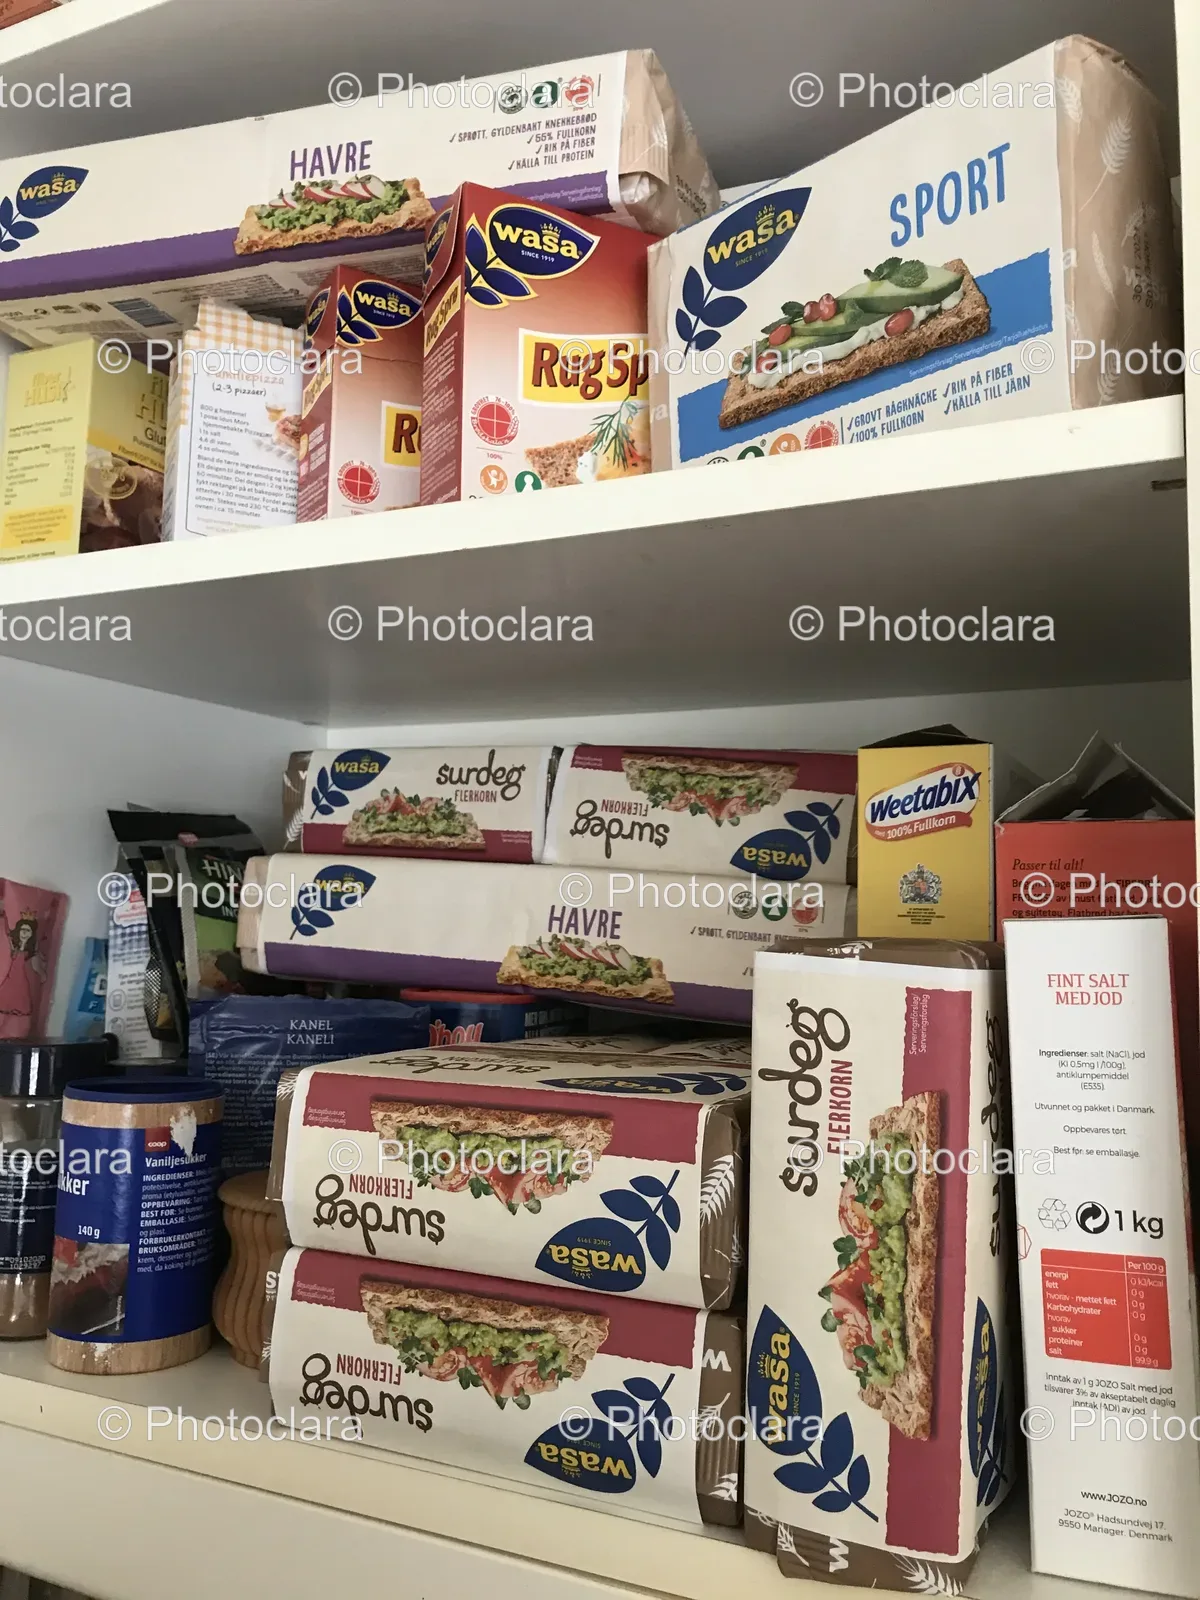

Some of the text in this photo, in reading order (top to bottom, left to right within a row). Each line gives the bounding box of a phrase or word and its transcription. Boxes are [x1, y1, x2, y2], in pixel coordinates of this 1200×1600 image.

[535, 125, 596, 143] 55% FULLKORN
[560, 138, 570, 150] PÅ
[573, 137, 595, 149] FIBER
[290, 140, 373, 182] HAVRE
[543, 154, 558, 165] TILL
[561, 149, 594, 163] PROTEIN
[20, 180, 79, 200] wasa
[889, 141, 1011, 248] SPORT
[492, 222, 582, 260] wasa
[707, 209, 796, 264] wasa
[521, 250, 555, 263] SINCE 1919
[355, 289, 411, 318] wasa
[951, 362, 1014, 396] RIK PÅ FIBER
[951, 374, 1031, 412] KÄLLA TILL JÄRN
[855, 388, 938, 430] GROVT RÅGKNÄCKE
[855, 411, 924, 443] 100% FULLKORN
[334, 760, 380, 774] wasa
[436, 749, 526, 801] surdeg
[454, 788, 497, 803] FLERKORN
[870, 772, 982, 823] Weetabix
[601, 799, 648, 817] FLERKORN
[569, 799, 670, 859] surdeg
[887, 825, 913, 840] 100%
[913, 815, 956, 834] Fullkorn
[742, 845, 808, 868] wasa
[1012, 858, 1084, 871] Passer til alt!
[548, 905, 623, 939] HAVRE
[1047, 973, 1130, 988] FINT SALT
[1055, 991, 1123, 1006] MED JOD
[290, 1019, 333, 1031] KANEL
[286, 1034, 335, 1045] KANELI
[1090, 1050, 1104, 1058] salt
[1132, 1050, 1146, 1060] jod
[1056, 1070, 1129, 1080] antiklumpemiddel
[757, 998, 852, 1197] surdeg
[826, 1059, 853, 1156] FLERKORN
[1034, 1102, 1070, 1111] Utvunnet
[1071, 1104, 1082, 1113] og
[1083, 1103, 1111, 1114] pakket
[1063, 1125, 1111, 1135] Oppbevares
[1053, 1146, 1071, 1155] Best
[145, 1153, 207, 1168] Vaniljesukker
[349, 1173, 413, 1200] FLERKORN
[141, 1210, 159, 1218] BEST
[313, 1173, 446, 1255] surdeg
[78, 1225, 101, 1239] 140 g
[1115, 1210, 1164, 1240] 1 kg
[549, 1242, 643, 1276] wasa
[1128, 1261, 1157, 1271] Per 100
[1045, 1271, 1069, 1281] energi
[1045, 1281, 1059, 1289] fett
[1046, 1291, 1117, 1305] hvorav mettet fett
[1046, 1303, 1101, 1316] Karbohydrater
[1047, 1314, 1071, 1323] hvorav
[1052, 1326, 1077, 1335] sukker
[1048, 1336, 1083, 1347] proteiner
[1049, 1347, 1063, 1355] salt
[336, 1352, 401, 1386] FLERKORN
[768, 1332, 791, 1445] wasa
[1045, 1373, 1071, 1383] Inntak
[1096, 1378, 1119, 1389] JOZO
[1120, 1381, 1136, 1391] Salt
[1138, 1384, 1158, 1393] med
[1159, 1385, 1173, 1395] jod
[300, 1352, 433, 1439] surdeg
[1044, 1384, 1176, 1408] tilsvarer 3% akseptabelt daglig
[538, 1442, 632, 1479] wasa
[1080, 1490, 1148, 1507] www.JOZO.no
[1096, 1514, 1152, 1529] Hadsundvej
[1058, 1519, 1173, 1543] 9550 Denmark
